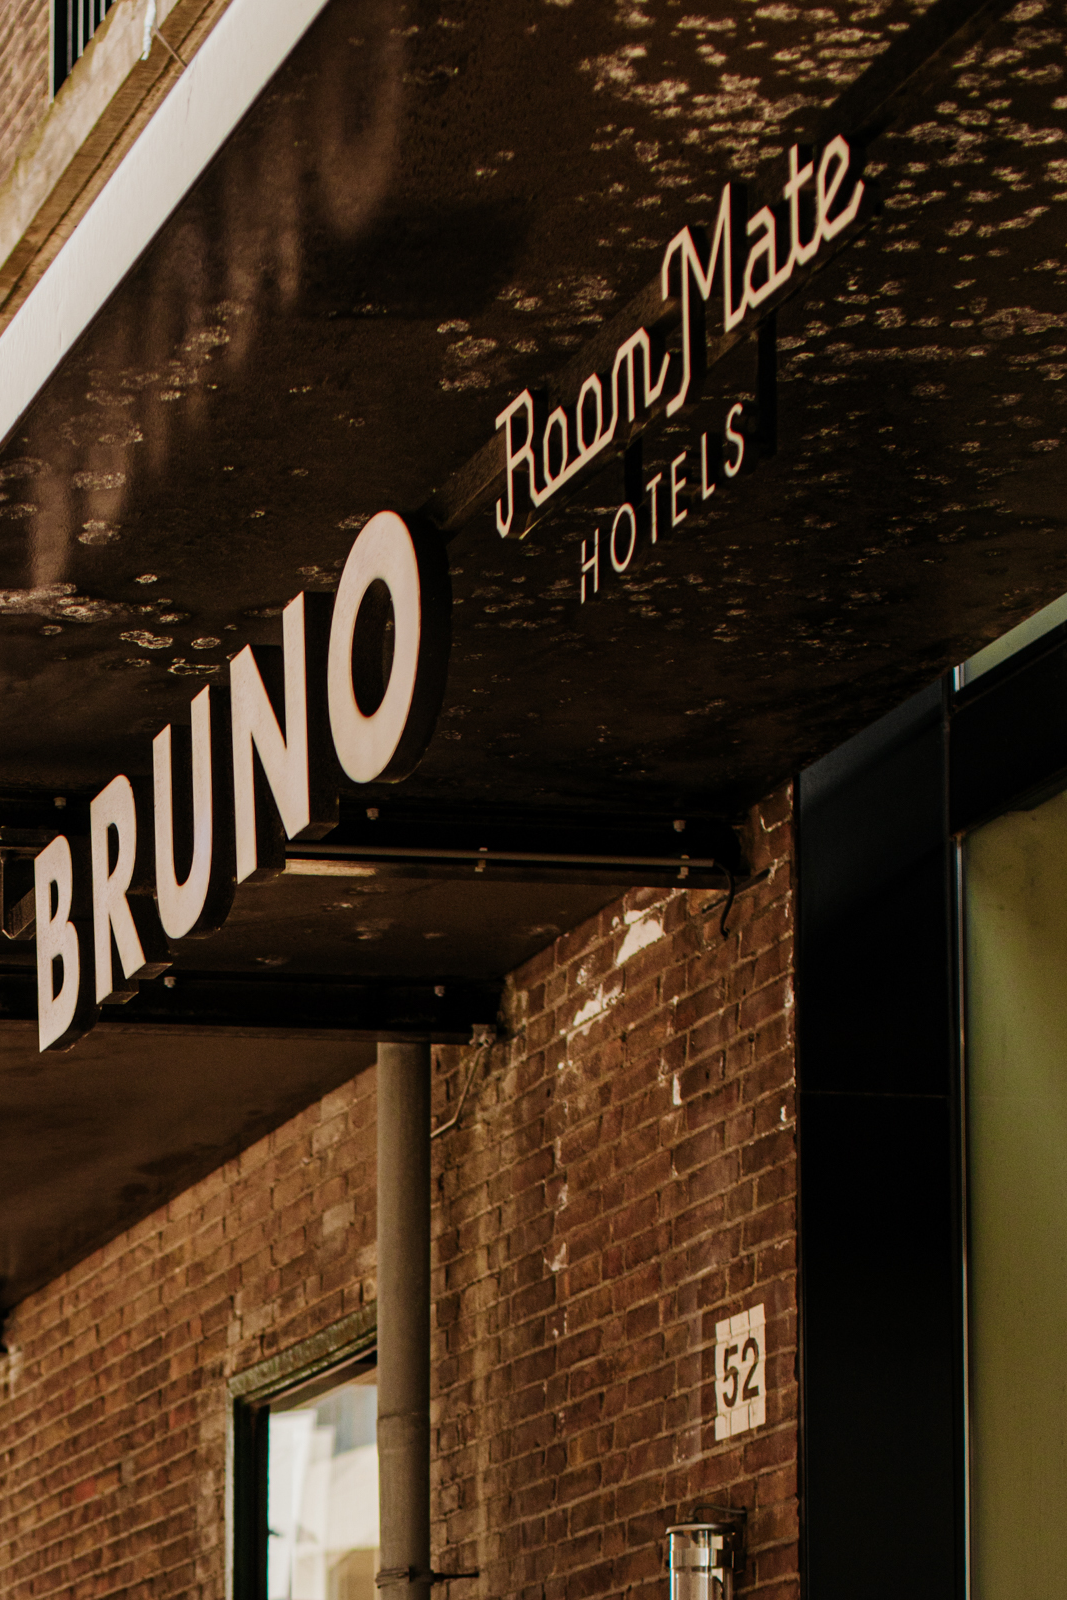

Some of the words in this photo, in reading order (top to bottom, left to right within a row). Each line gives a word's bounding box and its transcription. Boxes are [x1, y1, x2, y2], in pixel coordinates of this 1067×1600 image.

[496, 328, 670, 538] Room
[661, 135, 864, 417] Mate
[580, 403, 744, 604] HOTELS
[34, 510, 421, 1053] BRUNO
[722, 1337, 760, 1408] 52
